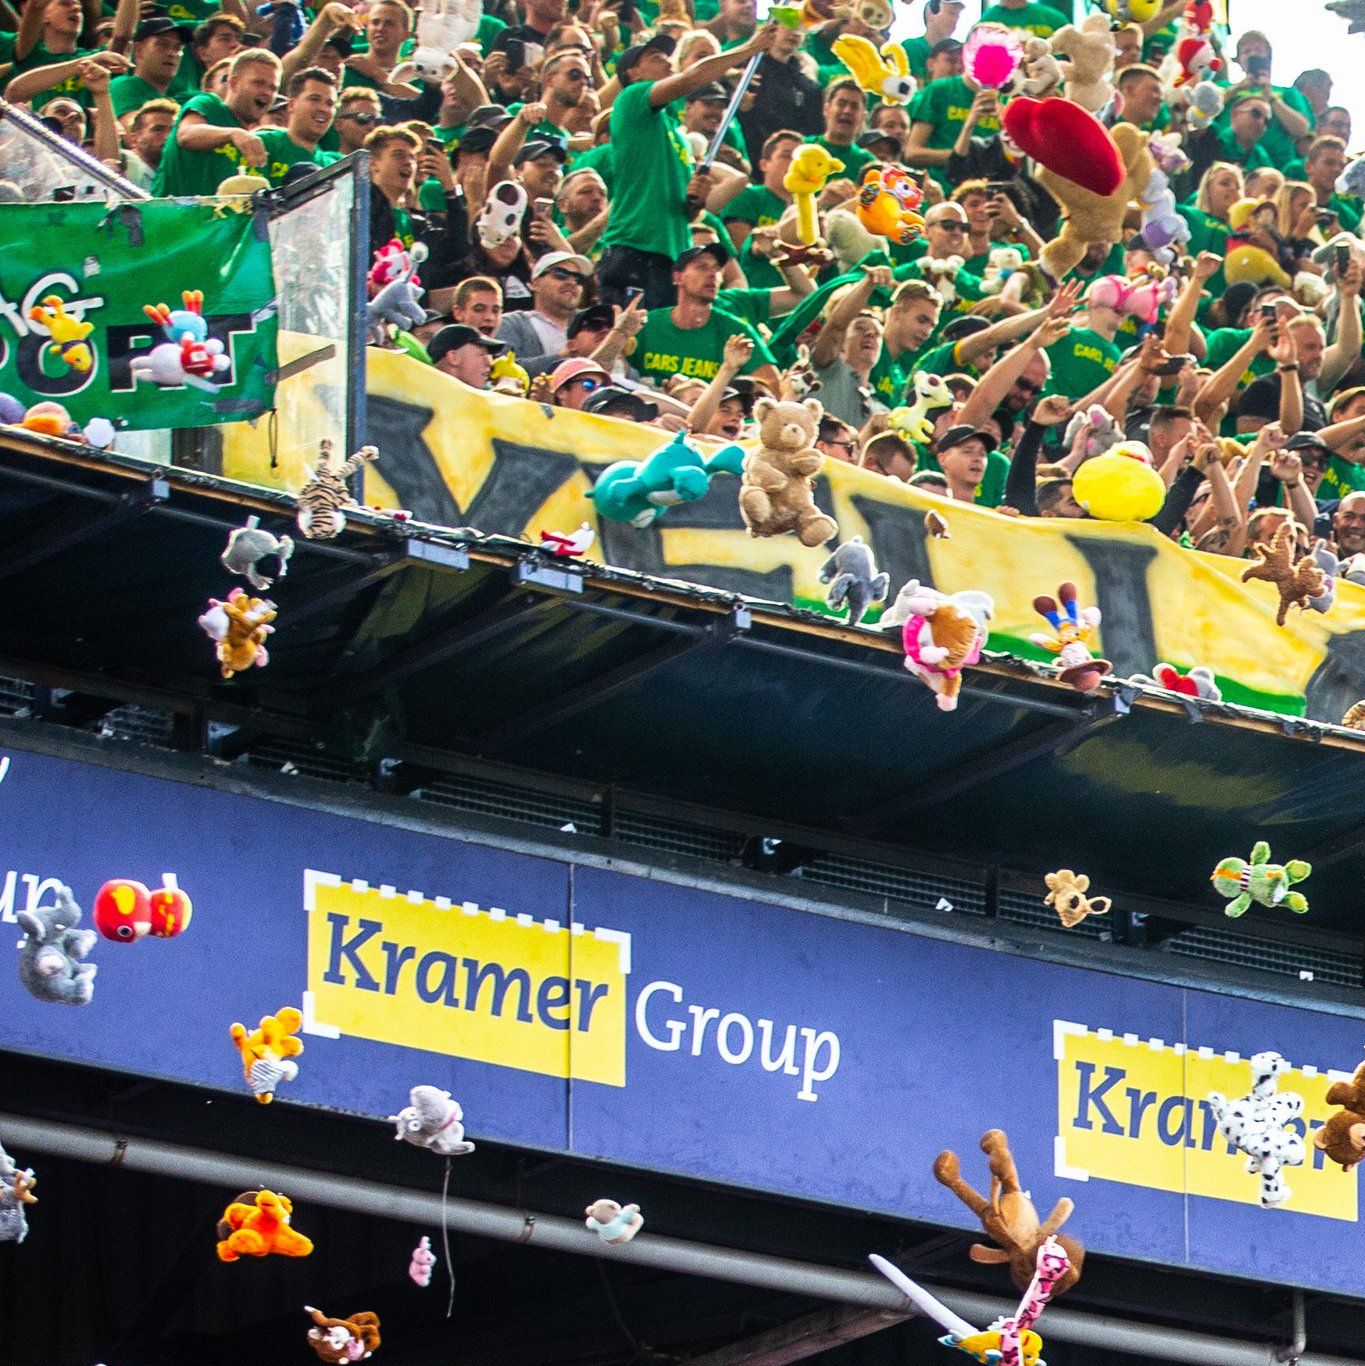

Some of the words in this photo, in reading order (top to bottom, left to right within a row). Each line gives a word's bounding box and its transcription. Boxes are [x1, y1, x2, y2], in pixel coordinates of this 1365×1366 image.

[643, 352, 679, 371] CARS
[323, 912, 609, 1032] Kramer
[636, 980, 841, 1102] Group
